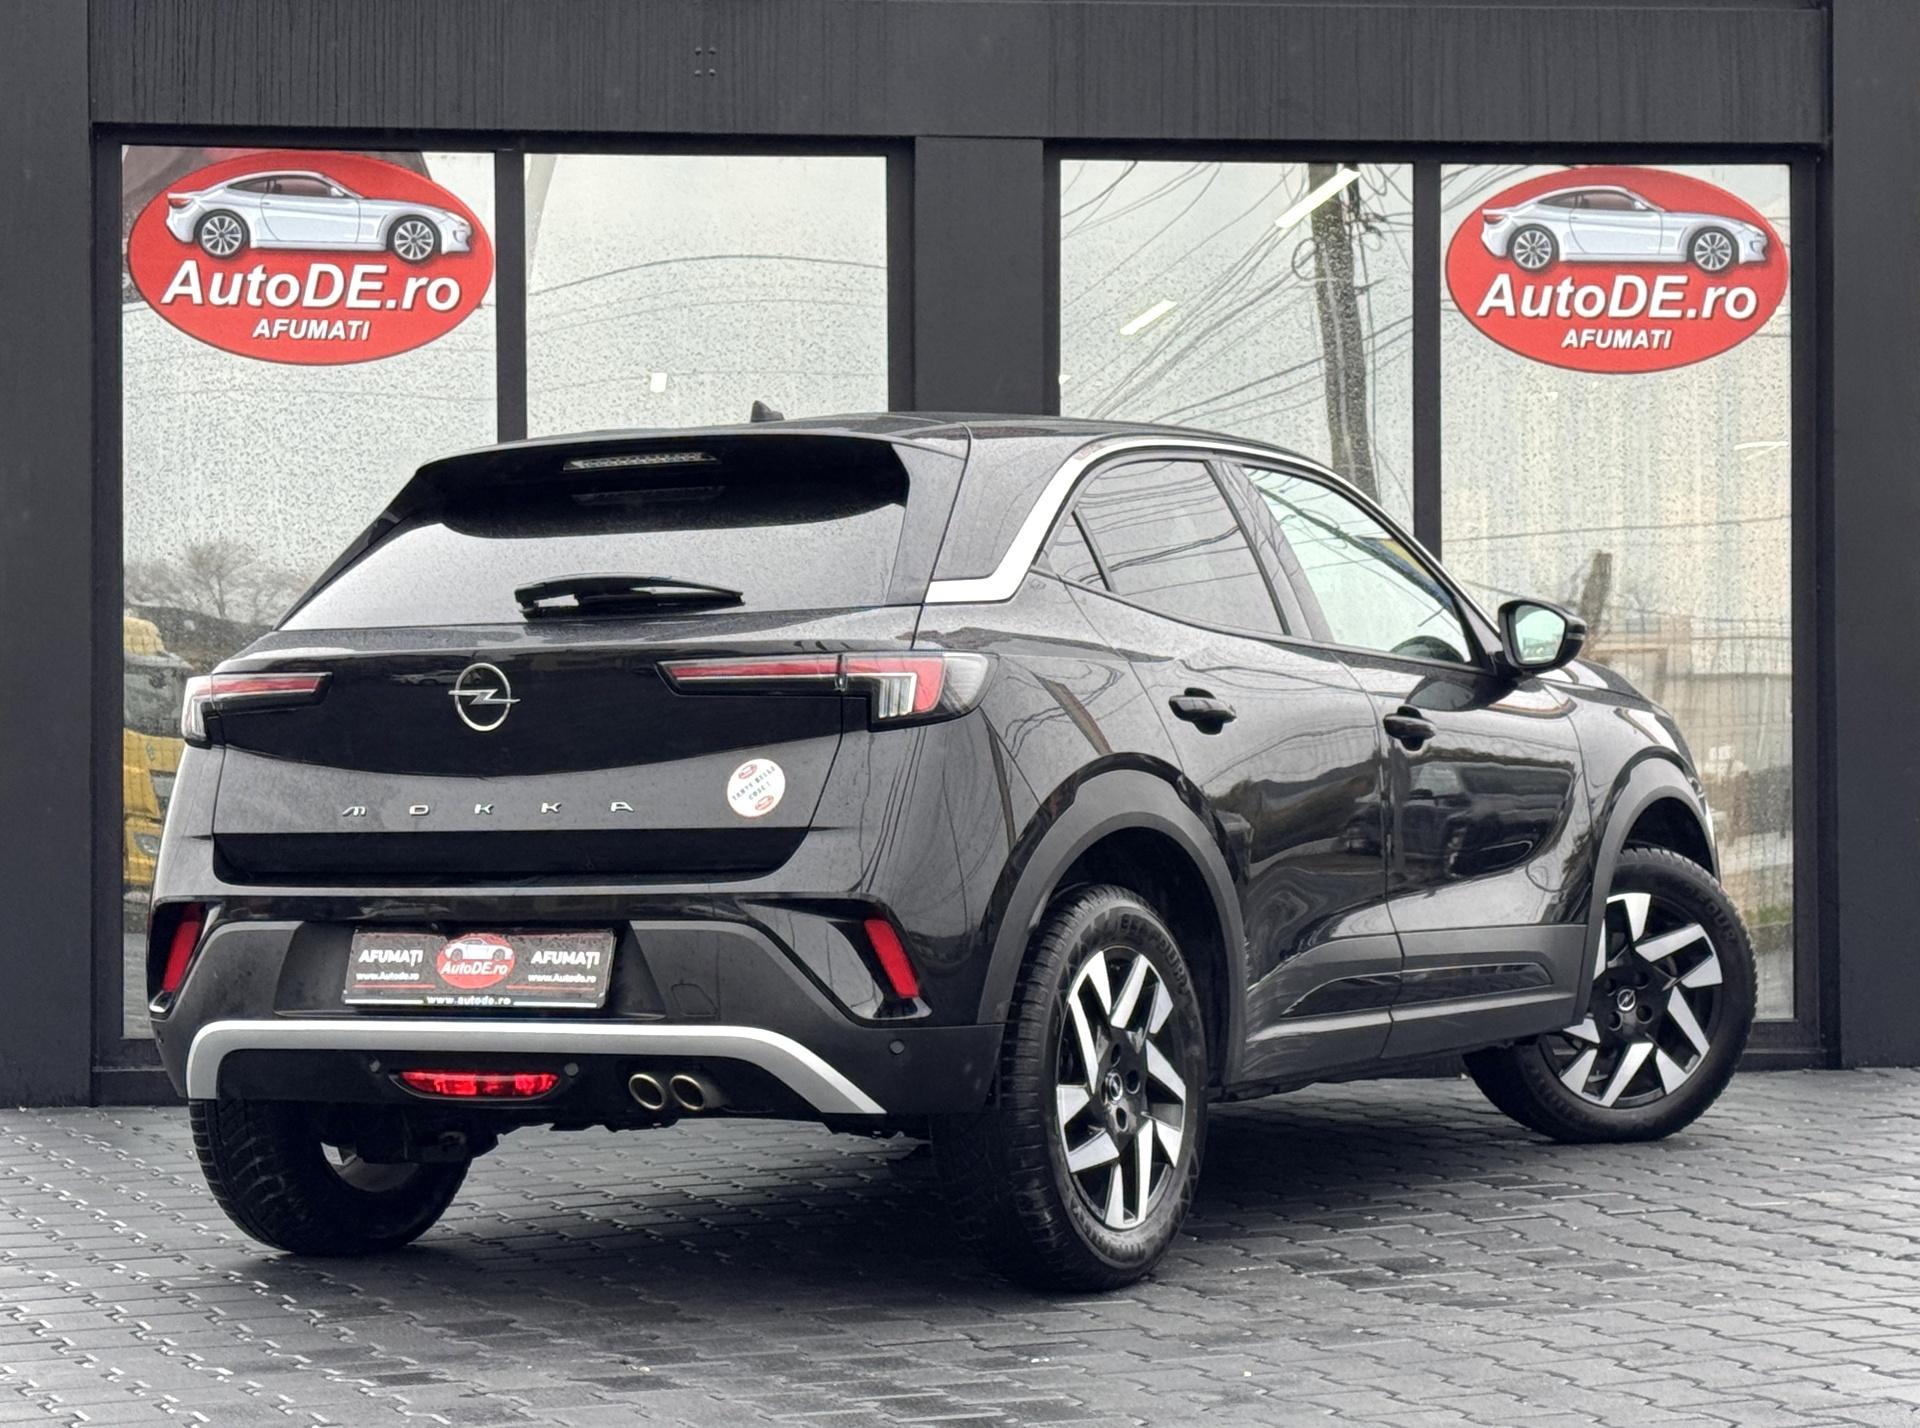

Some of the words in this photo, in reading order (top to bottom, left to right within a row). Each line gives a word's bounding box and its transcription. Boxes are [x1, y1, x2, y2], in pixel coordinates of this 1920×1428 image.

[161, 259, 461, 311] AutoDE.ro
[1477, 273, 1758, 320] AutoDE.ro
[252, 318, 370, 341] AFUMATI
[1561, 329, 1672, 349] AFUMATI
[342, 801, 634, 817] MOKKA
[440, 961, 508, 976] AutoDE.ro
